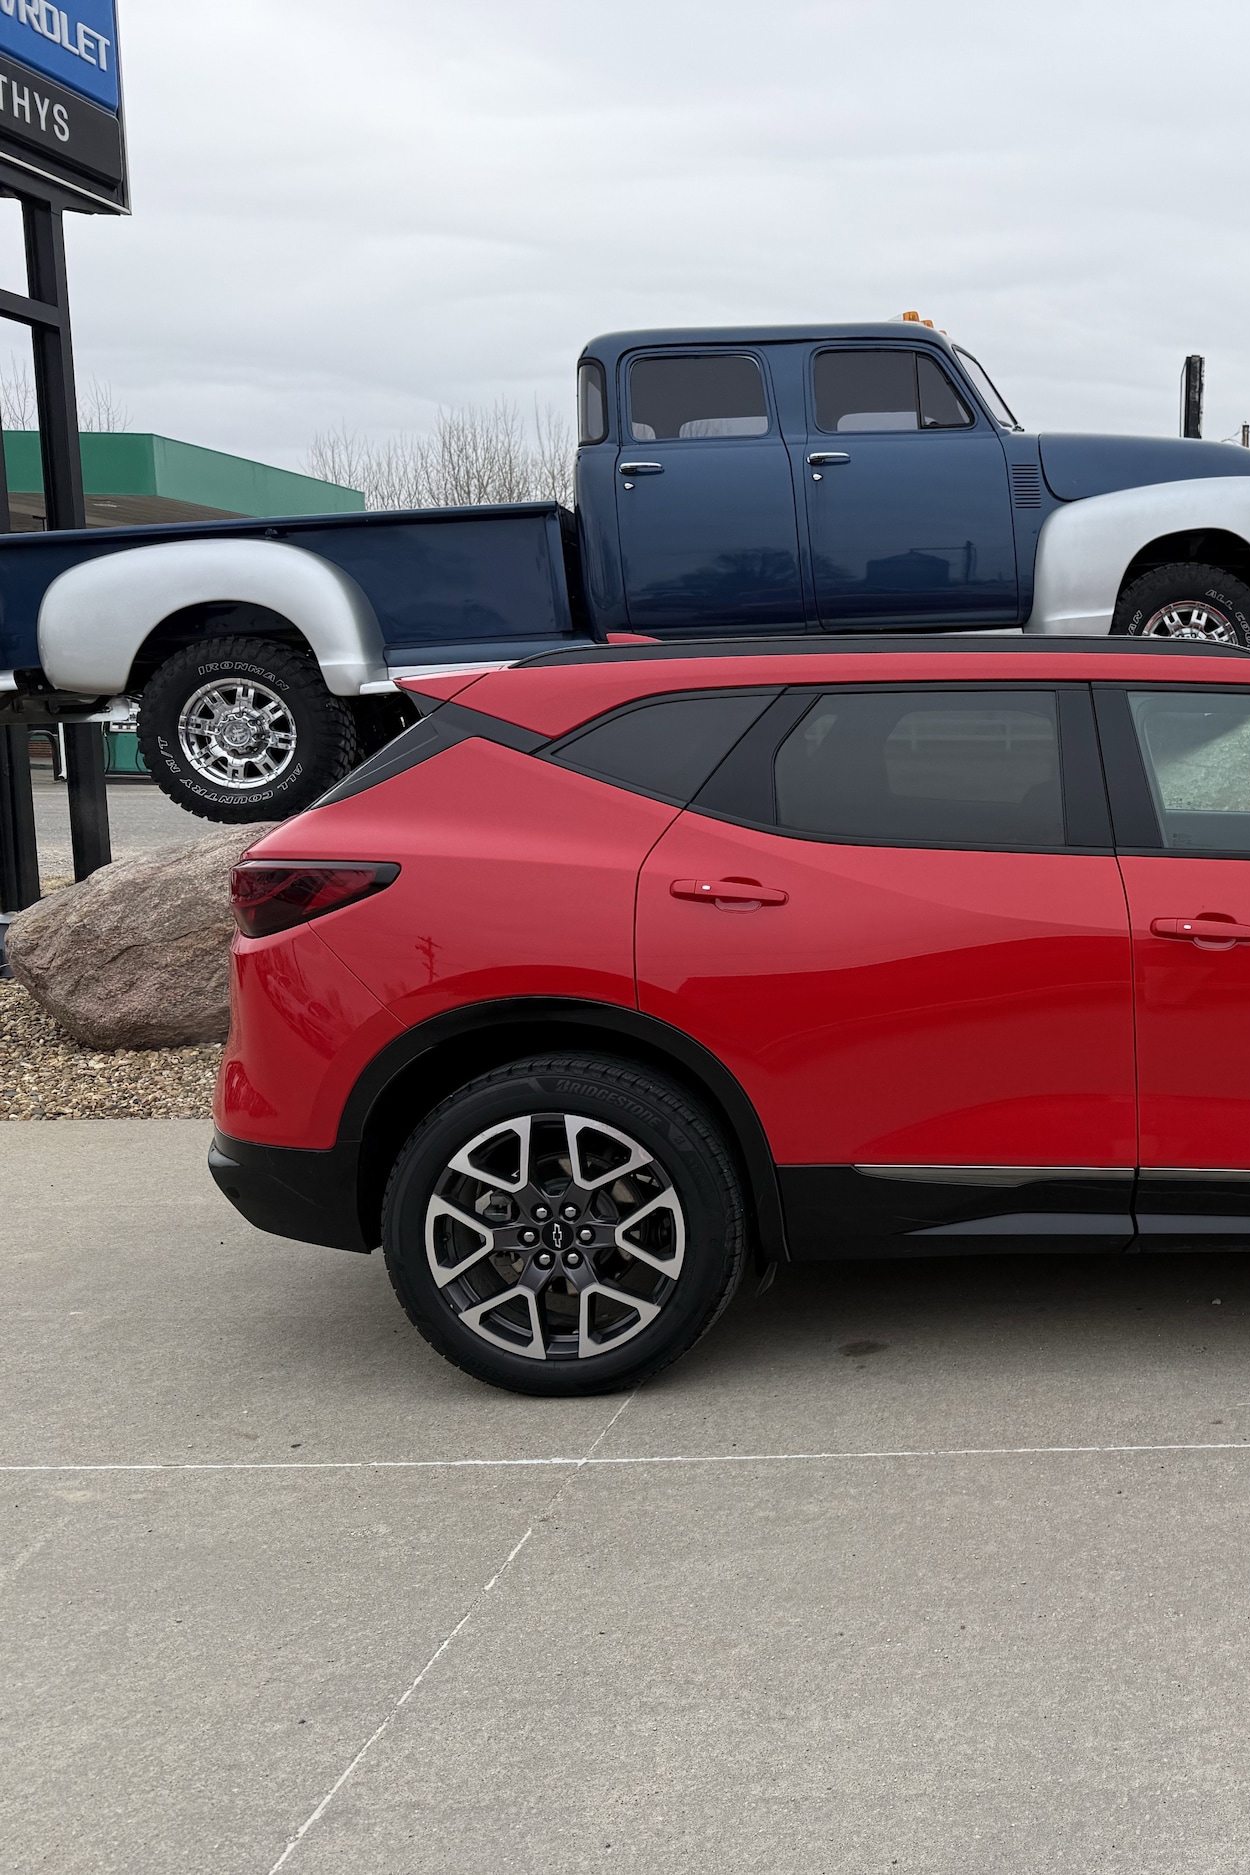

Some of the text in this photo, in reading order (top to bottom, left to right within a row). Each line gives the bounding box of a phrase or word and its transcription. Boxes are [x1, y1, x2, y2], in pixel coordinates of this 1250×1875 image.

[198, 661, 289, 691] IRONMAN
[277, 763, 304, 790] ALL
[180, 778, 274, 804] COUNTRY
[554, 1079, 662, 1127] BRIDGESTONE
